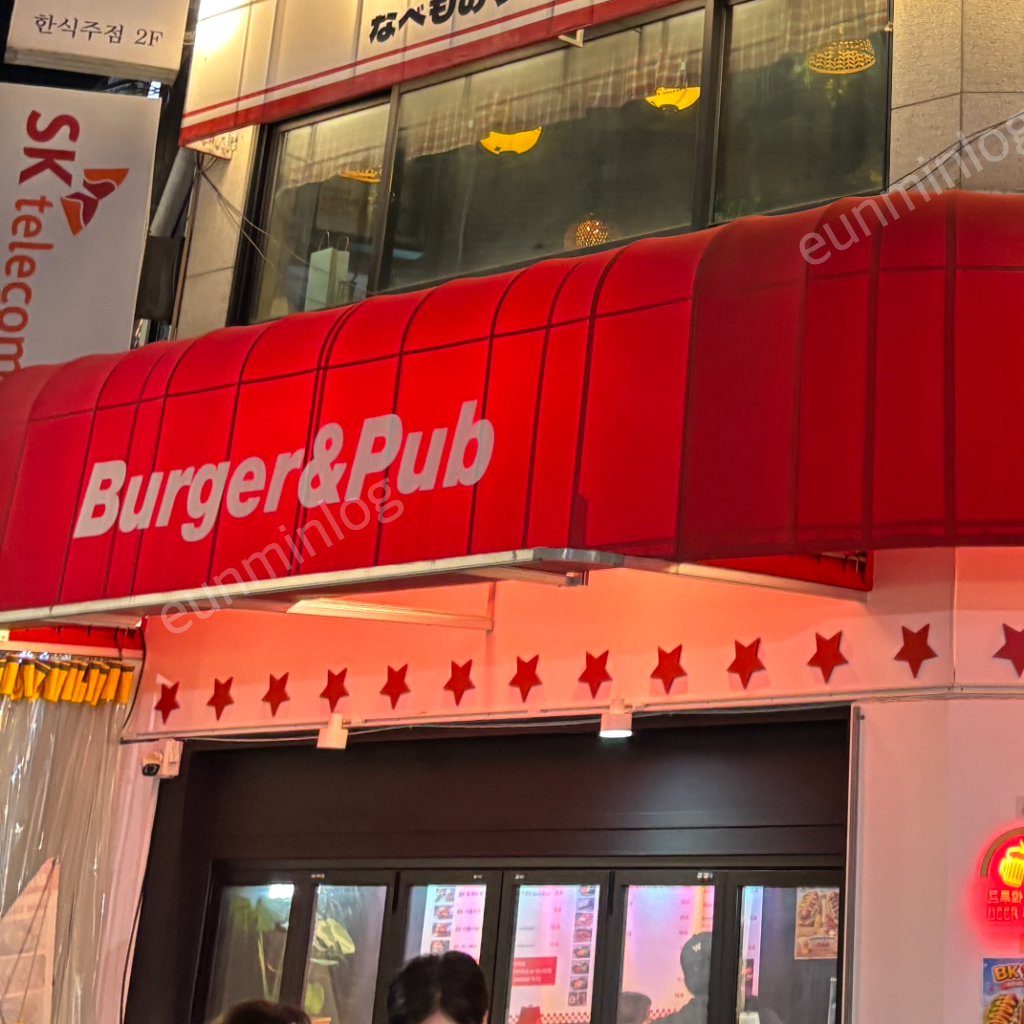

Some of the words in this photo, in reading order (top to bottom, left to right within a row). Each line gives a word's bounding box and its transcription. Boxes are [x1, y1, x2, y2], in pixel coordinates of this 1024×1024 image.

[34, 13, 124, 45] 한식주점
[134, 28, 164, 47] 2F
[18, 109, 81, 187] SK
[0, 195, 54, 373] telecom
[73, 400, 495, 542] Burger&Pub
[993, 965, 1020, 982] BK
